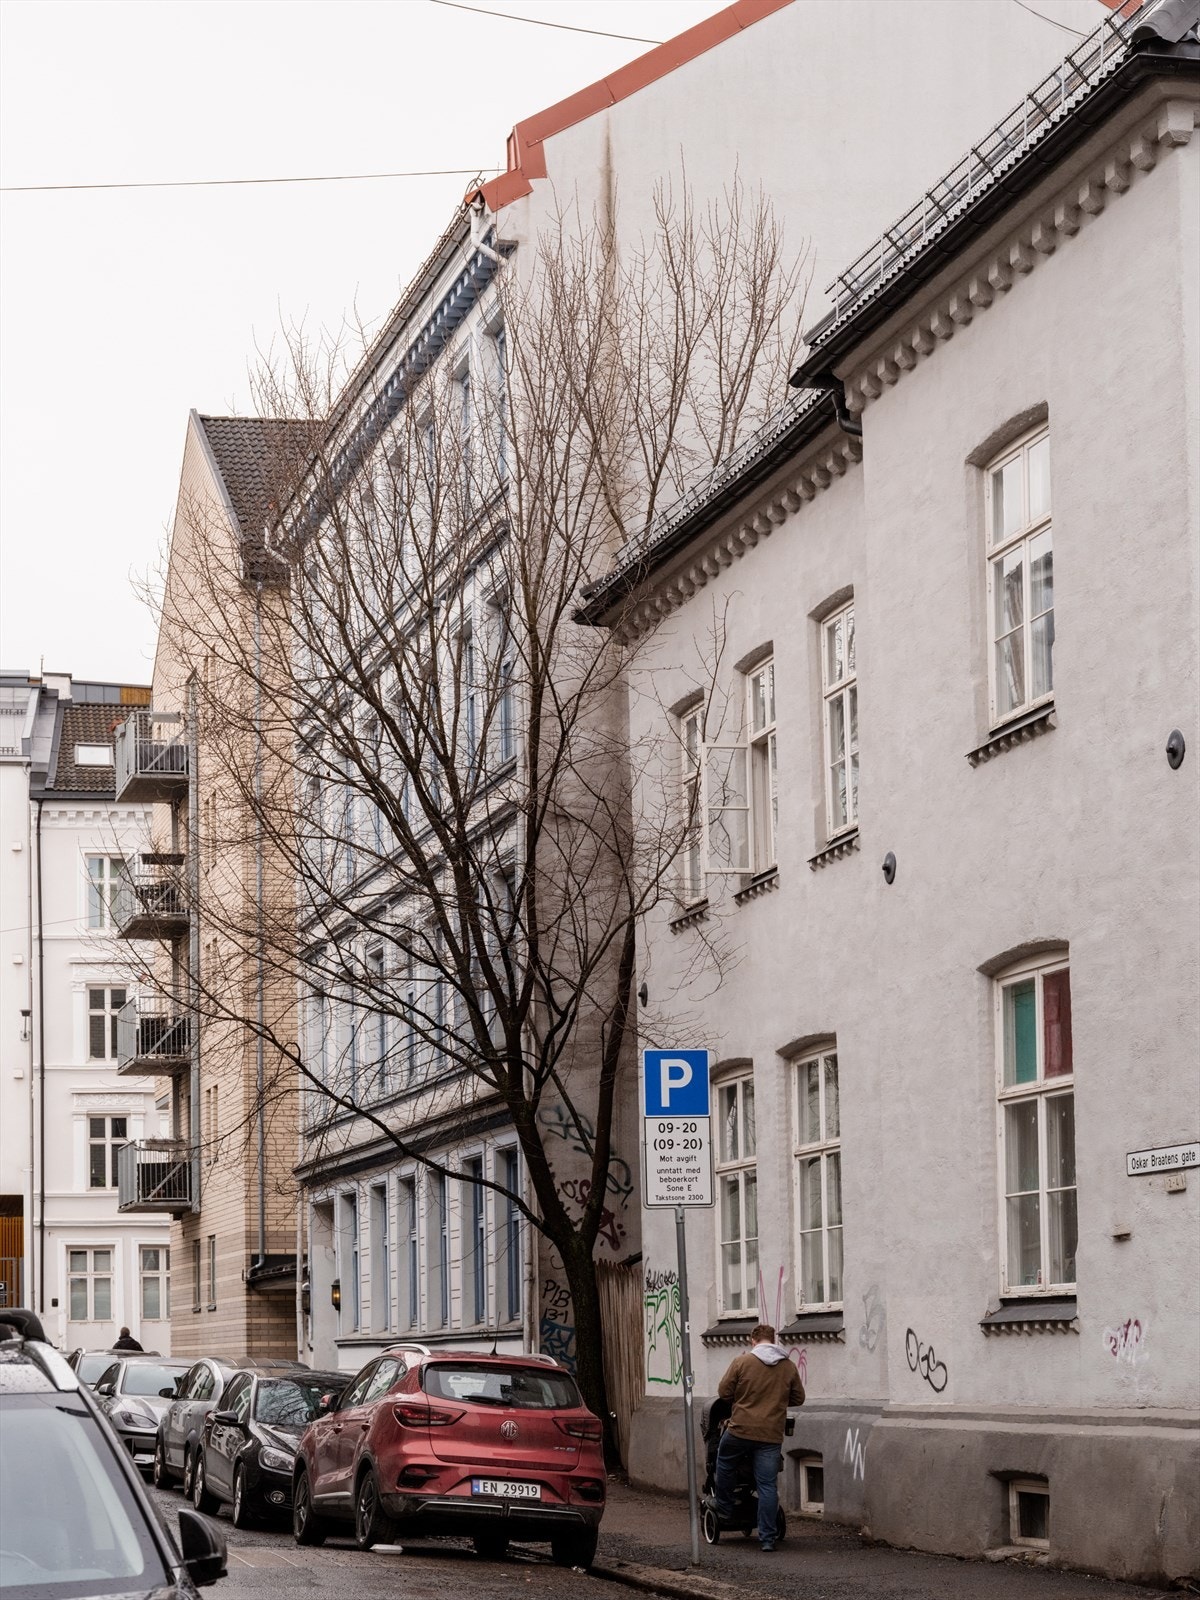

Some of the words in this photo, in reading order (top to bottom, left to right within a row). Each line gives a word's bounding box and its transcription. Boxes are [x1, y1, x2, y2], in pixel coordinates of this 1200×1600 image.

[660, 1058, 693, 1108] P
[676, 1155, 697, 1163] avgift
[1131, 1157, 1149, 1170] Oskar
[1151, 1153, 1179, 1167] Braatens
[1181, 1150, 1196, 1165] gate
[501, 1420, 519, 1439] MG
[482, 1482, 498, 1493] EN
[503, 1483, 538, 1497] 29919
